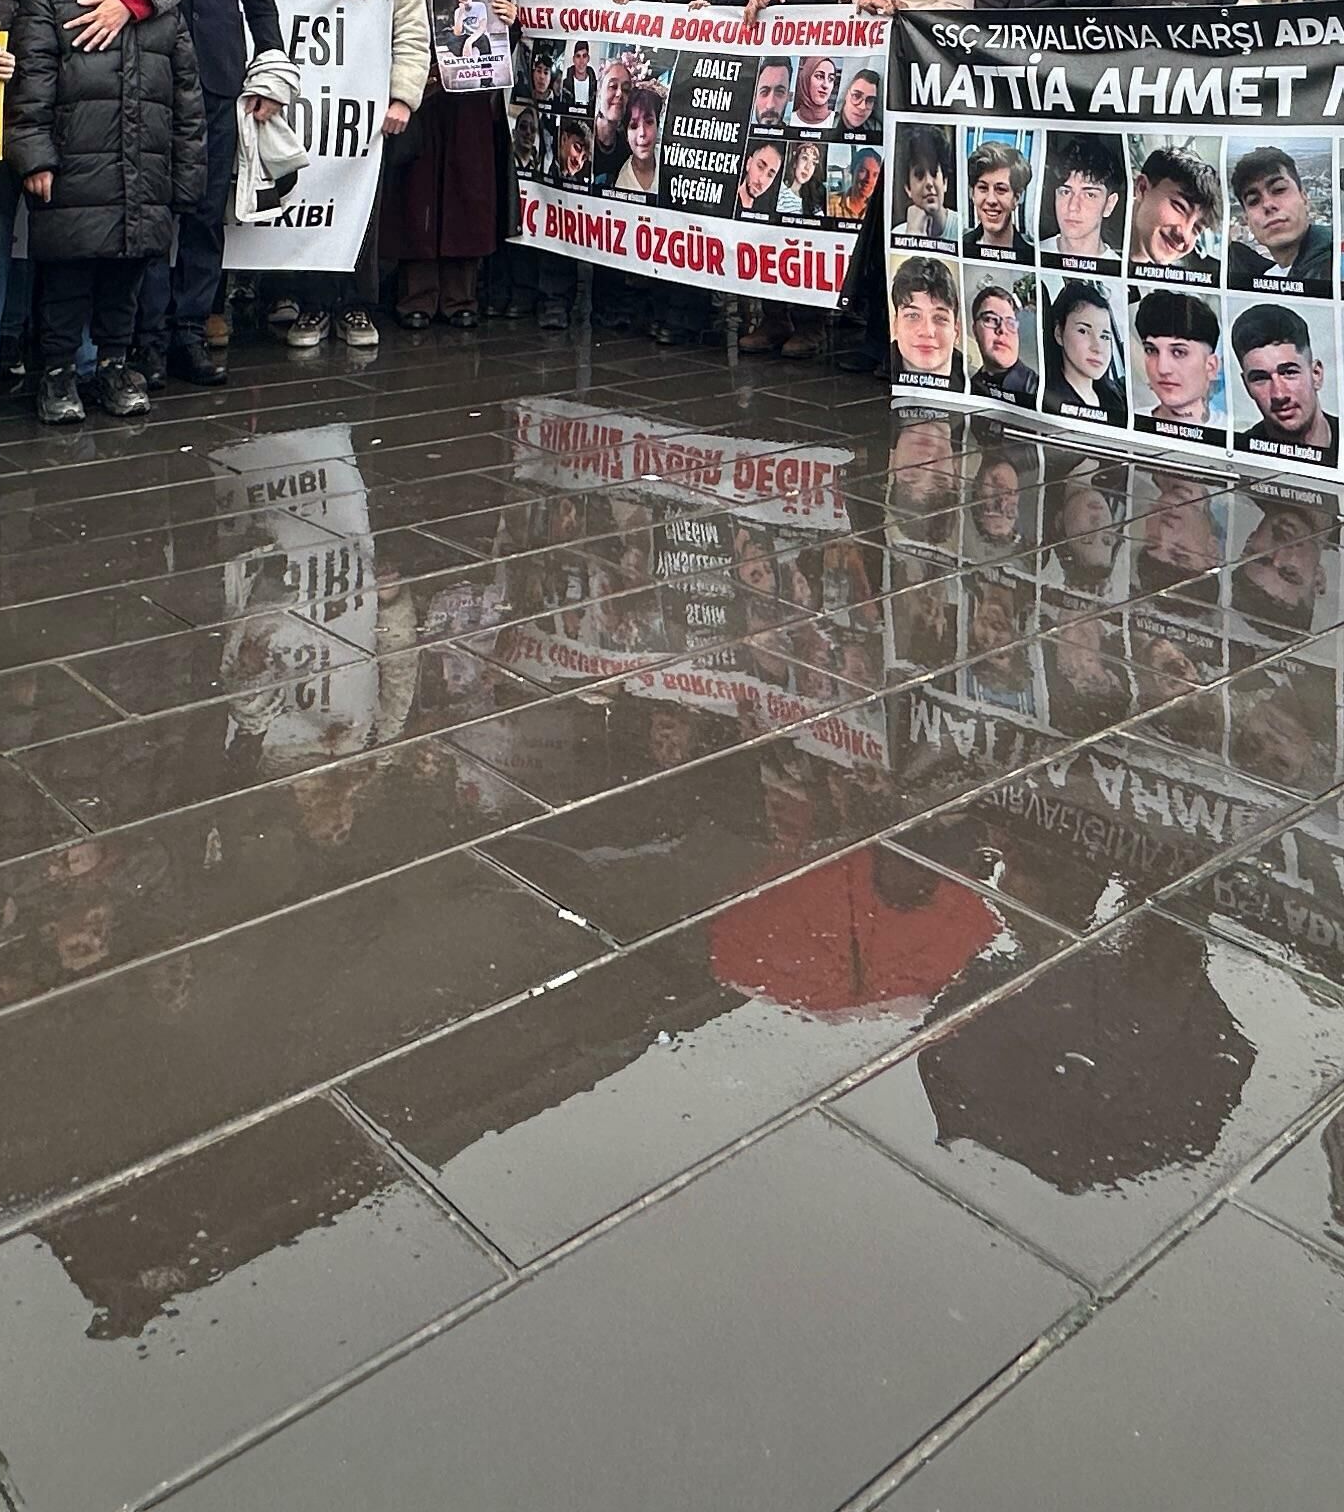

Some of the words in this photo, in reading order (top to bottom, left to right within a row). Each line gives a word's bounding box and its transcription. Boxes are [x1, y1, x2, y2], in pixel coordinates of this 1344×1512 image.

[290, 7, 345, 67] ESİ
[517, 6, 554, 30] ALET
[559, 7, 665, 39] ÇOCUKLARA
[670, 18, 766, 46] BORCUNU
[771, 15, 888, 48] ÖDEMEDİKÇE
[931, 23, 981, 54] SSÇ
[985, 17, 1162, 51] ZIRVALIĞINA
[1167, 21, 1264, 55] KARŞI
[459, 69, 494, 78] ADALET
[693, 58, 742, 81] ADALET
[909, 52, 1076, 112] MATTİA
[1088, 64, 1308, 117] AHMET
[692, 87, 733, 111] SENİN
[287, 86, 376, 158] DİR!
[672, 116, 741, 143] ELLERİNDE
[663, 143, 741, 175] YÜKSELECEK
[670, 175, 723, 205] ÇİÇEĞİM
[254, 198, 334, 227] KİBİ
[545, 199, 627, 256] BİRİMİZ
[635, 216, 725, 276] ÖZGÜR
[737, 238, 855, 293] DEĞİLİ
